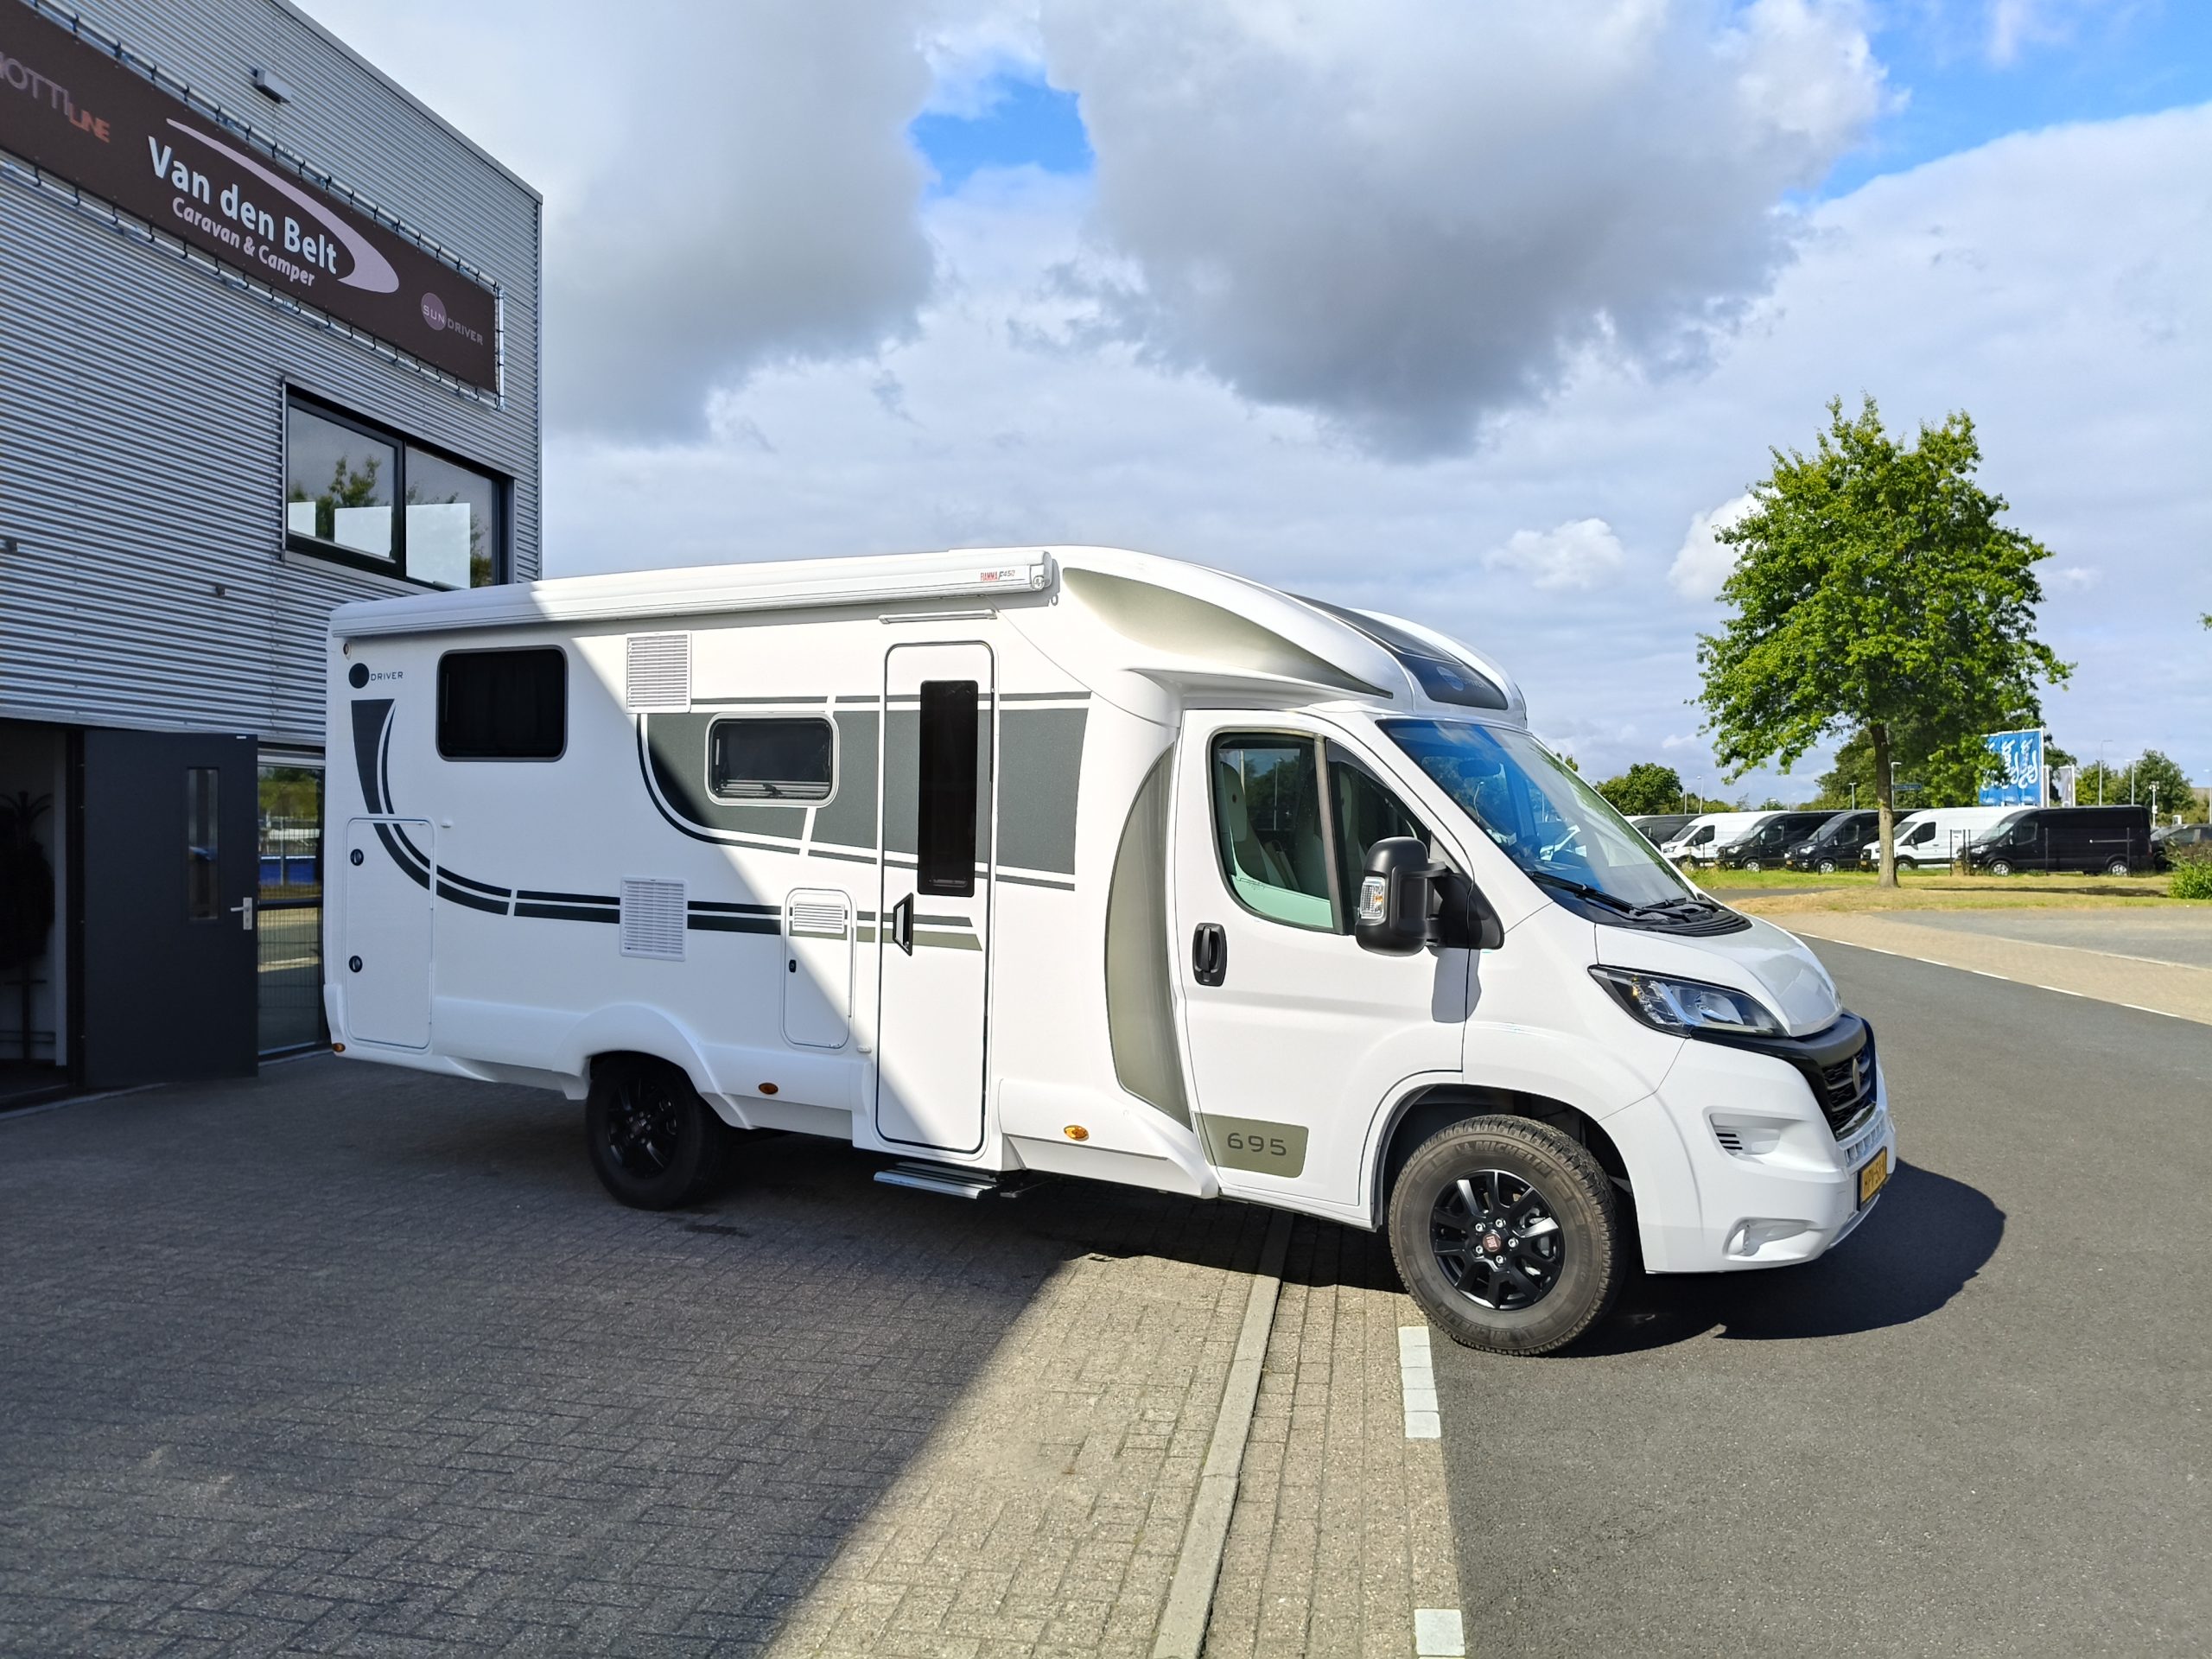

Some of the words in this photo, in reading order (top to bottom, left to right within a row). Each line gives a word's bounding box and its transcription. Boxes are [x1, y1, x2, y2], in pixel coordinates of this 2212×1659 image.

[148, 136, 210, 205] Van
[219, 183, 275, 242] den
[284, 216, 337, 275] Belt
[172, 197, 240, 249] Caravan
[243, 236, 256, 257] &
[258, 245, 315, 287] Camper
[423, 305, 445, 324] SUN
[448, 317, 484, 346] DRIVER
[370, 671, 404, 682] DRIVER
[1227, 1132, 1287, 1156] 695
[1475, 1141, 1554, 1179] MICHELIN
